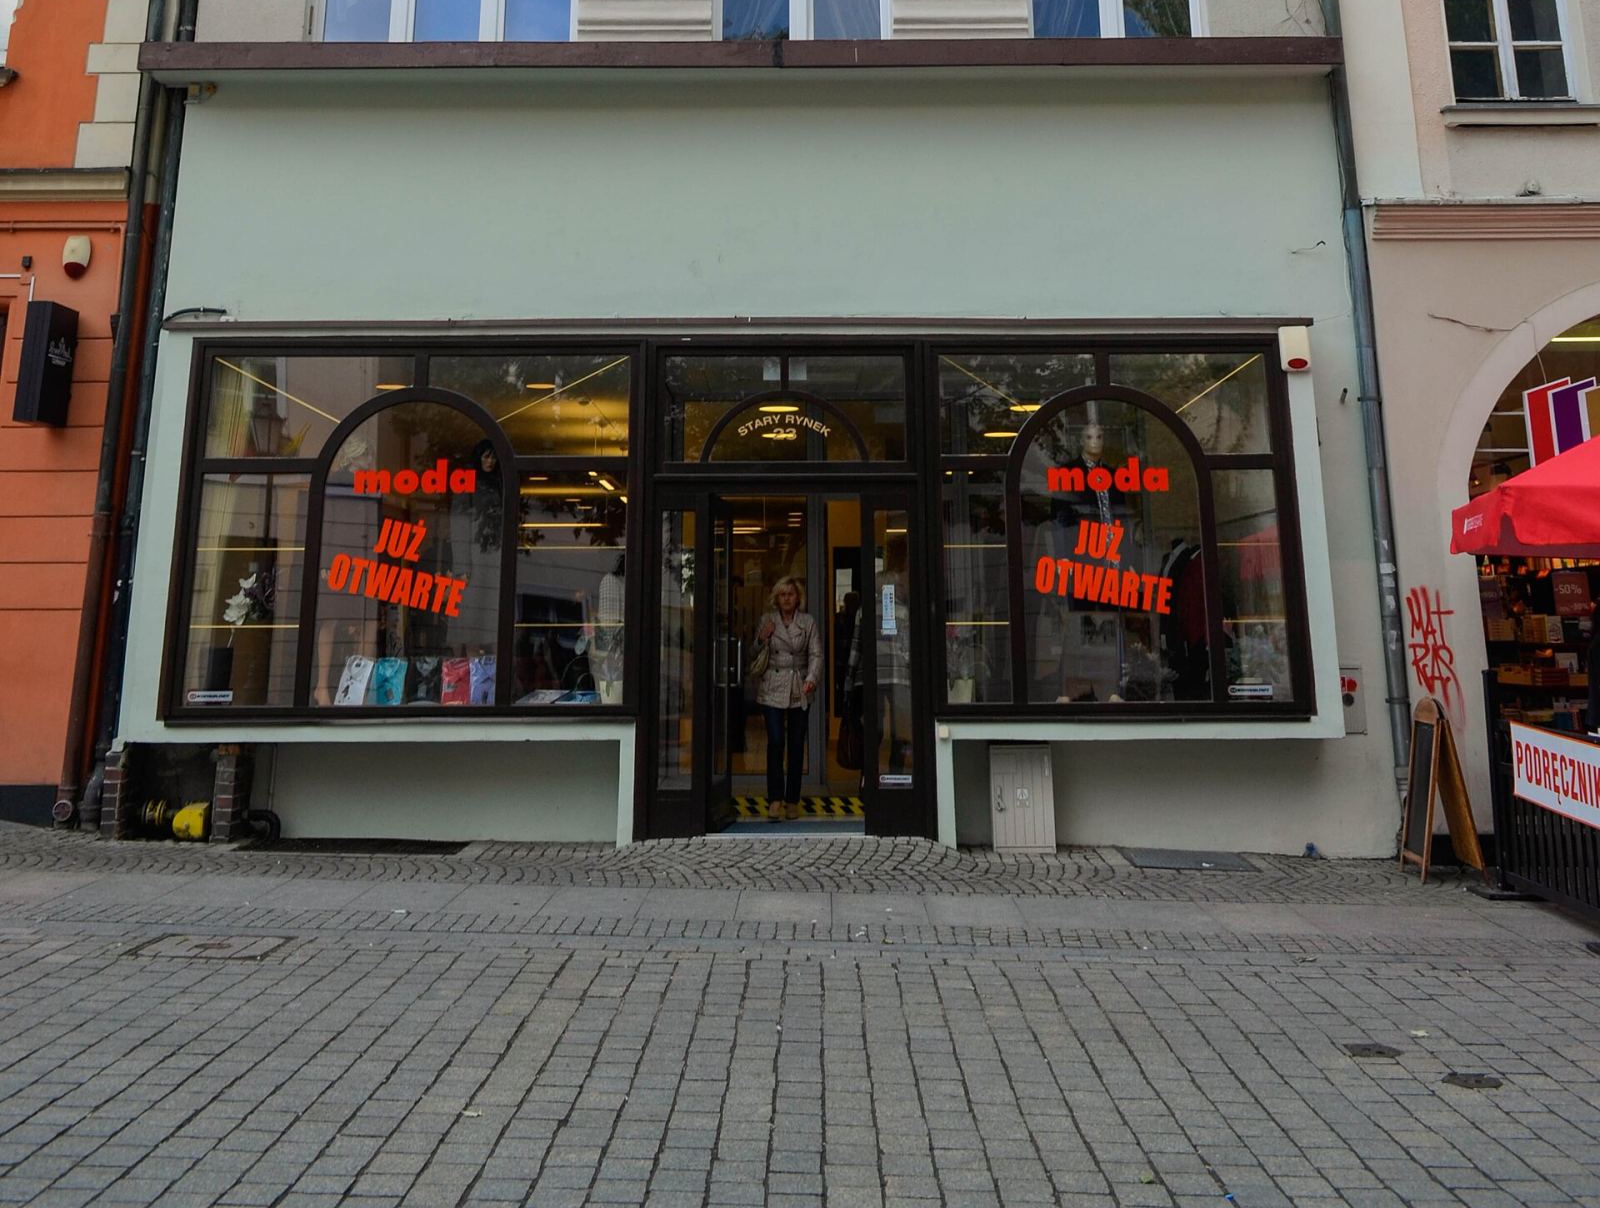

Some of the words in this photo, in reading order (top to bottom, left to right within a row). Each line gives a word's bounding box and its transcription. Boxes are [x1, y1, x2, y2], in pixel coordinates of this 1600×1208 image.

[737, 414, 781, 437] STARY
[785, 414, 832, 438] RYNEK
[772, 427, 797, 441] 23
[353, 458, 476, 494] moda
[1047, 456, 1170, 492] moda
[373, 518, 427, 562] JUŻ
[1074, 519, 1125, 562] JUŻ
[327, 553, 467, 618] OTWARTE
[1035, 555, 1173, 615] OTWARTE
